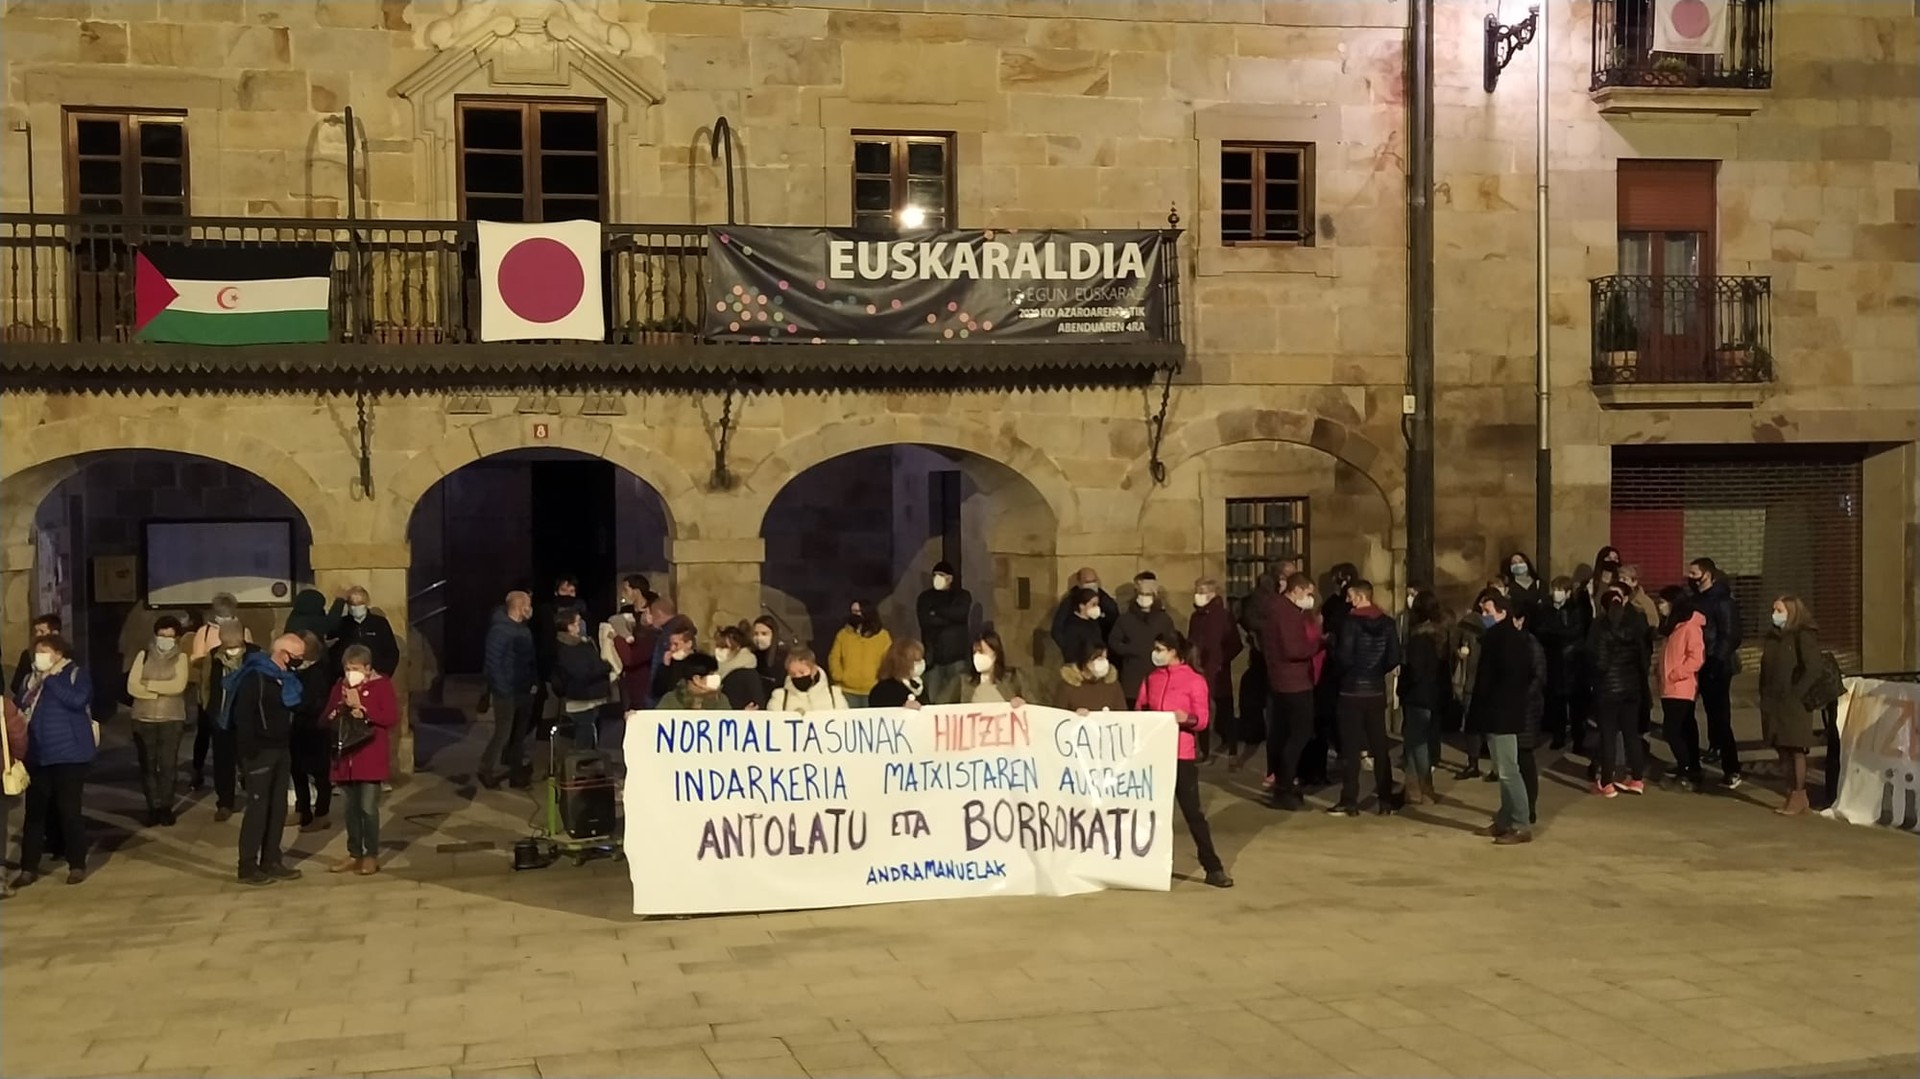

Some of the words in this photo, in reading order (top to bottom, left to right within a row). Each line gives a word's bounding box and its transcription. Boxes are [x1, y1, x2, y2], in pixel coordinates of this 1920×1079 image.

[830, 241, 1146, 280] EUSKARALDIA
[1027, 287, 1068, 302] EGUN
[1075, 286, 1145, 302] EUSKARAZ
[1058, 322, 1125, 333] ABENDUAREN
[1126, 322, 1146, 333] 4RA
[536, 424, 546, 438] 8
[656, 717, 913, 754] NORMALTASUNAK
[934, 710, 1030, 751] HILTZEN
[1054, 718, 1135, 762] GAITU
[675, 763, 848, 804] INDARKERIA
[884, 757, 1039, 795] MATXISTAREN
[1059, 764, 1153, 801] AURREAN
[697, 808, 867, 861] ANTOLATU
[891, 810, 931, 839] ETA
[962, 799, 1156, 861] BORROKATU
[866, 859, 1007, 886] ANDRAMANUELAK
